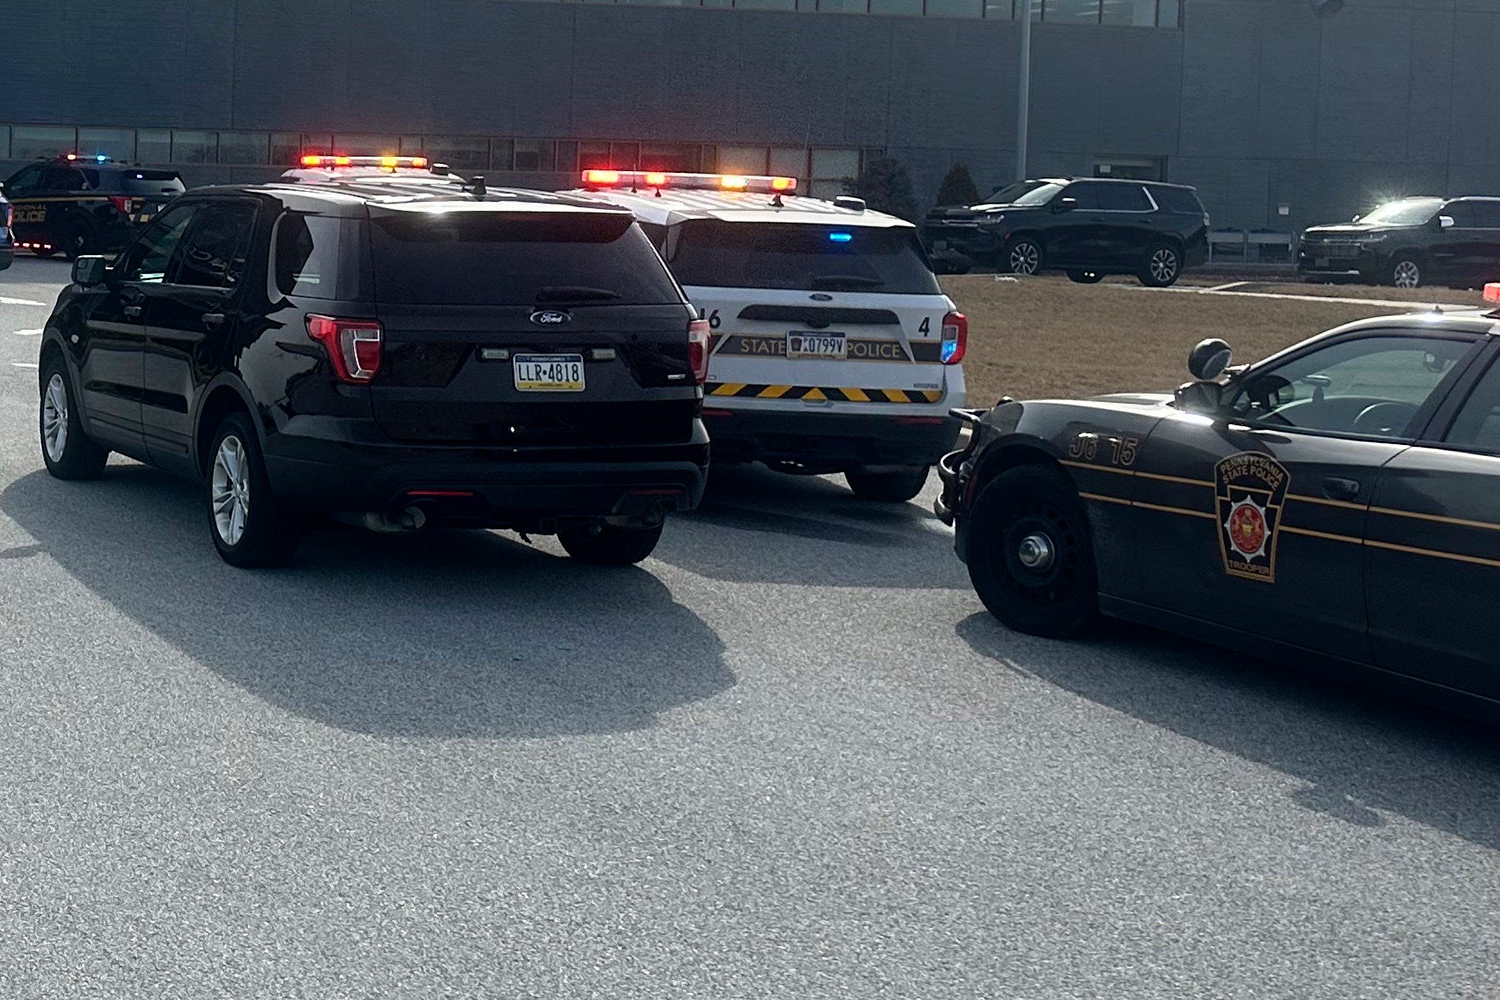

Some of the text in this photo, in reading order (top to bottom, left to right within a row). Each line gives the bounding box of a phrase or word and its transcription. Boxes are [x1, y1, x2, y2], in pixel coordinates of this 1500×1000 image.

[13, 211, 47, 222] OLICE
[918, 317, 930, 337] 4
[740, 338, 900, 358] STATE POLICE
[1220, 455, 1284, 483] PENNSYLVANIA
[1222, 465, 1280, 491] STATE POLICE
[1228, 561, 1270, 576] TROOPER
